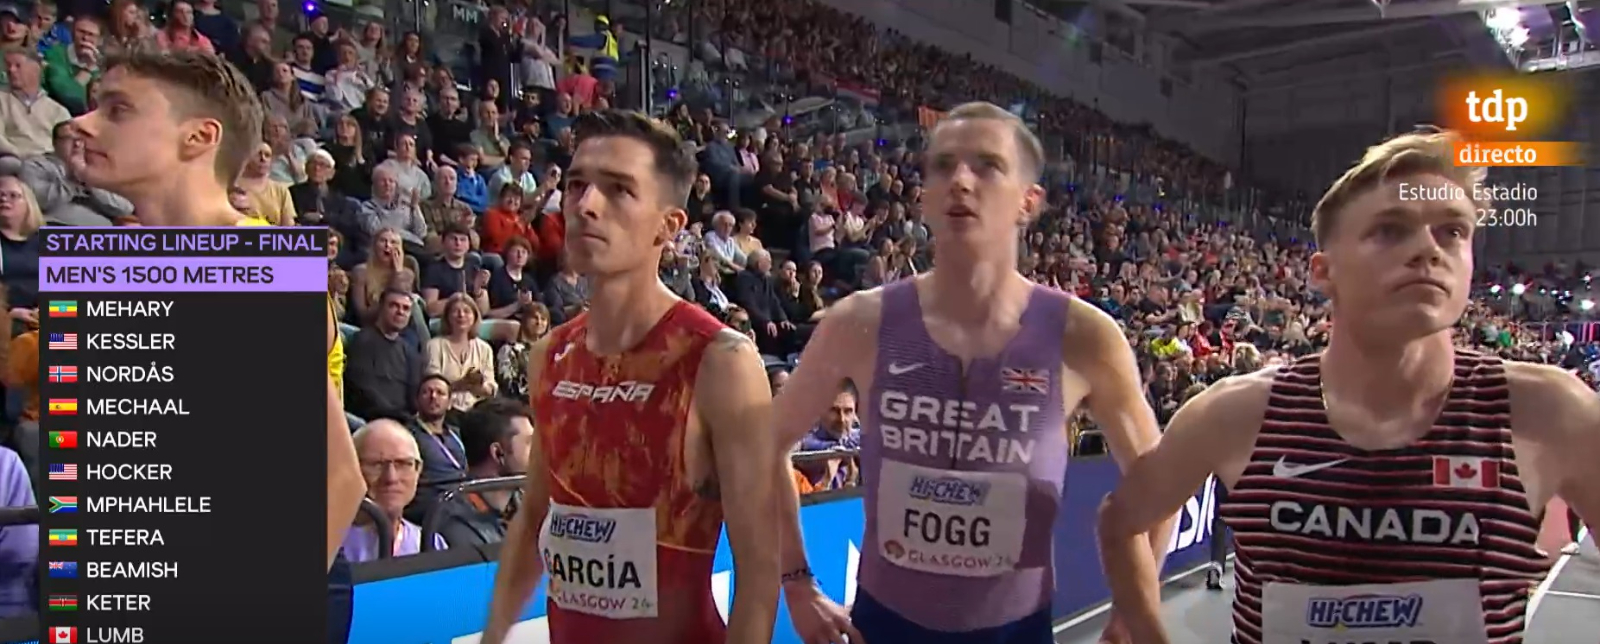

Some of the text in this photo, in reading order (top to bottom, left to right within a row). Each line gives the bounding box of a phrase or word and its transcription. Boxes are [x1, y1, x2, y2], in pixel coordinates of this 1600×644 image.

[552, 380, 656, 404] ESPAÑA
[880, 390, 1040, 432] GREAT
[880, 425, 1036, 465] BRITAIN
[903, 508, 991, 547] FOGG
[1270, 500, 1480, 546] CANADA
[908, 549, 992, 569] GLASGOW
